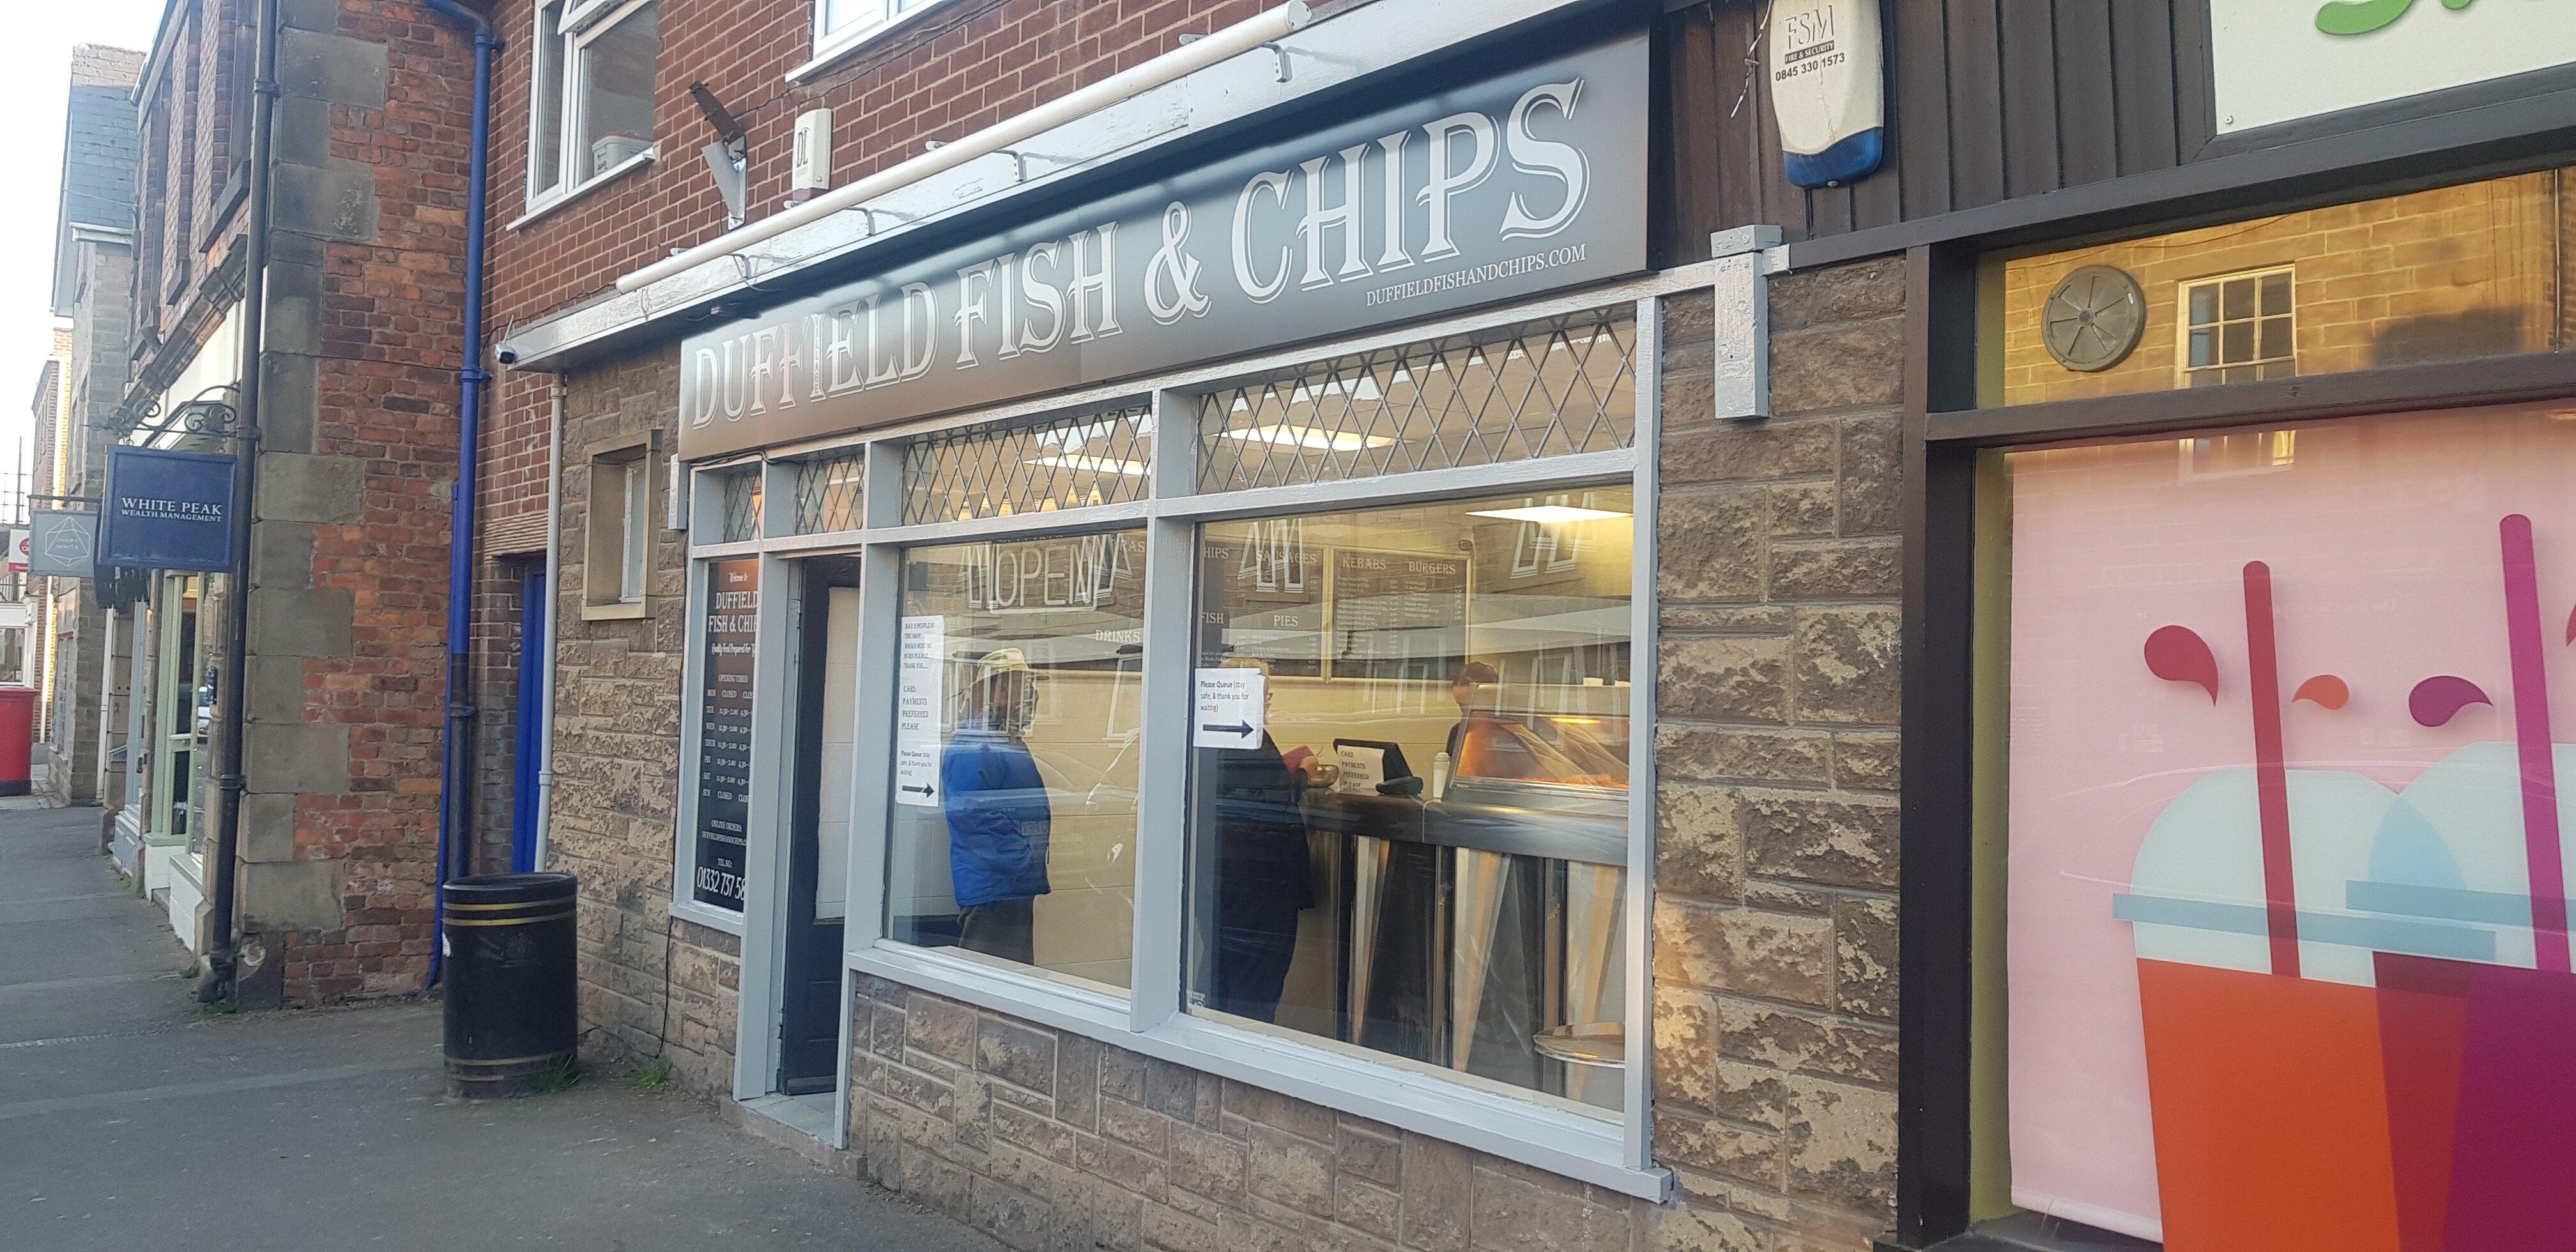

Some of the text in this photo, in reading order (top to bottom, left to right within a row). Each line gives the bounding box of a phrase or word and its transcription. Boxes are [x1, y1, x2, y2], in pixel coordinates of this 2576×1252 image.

[1785, 5, 1834, 49] FSM
[1785, 41, 1834, 63] FIRE & SECURITY
[1775, 52, 1845, 81] 0845 330 1573
[693, 77, 1590, 429] DUFFIELD FISH & CHIPS
[1366, 243, 1586, 307] DUFFIELDFISHANDCHIPS.COM
[121, 498, 222, 515] WHITE PEAK
[121, 509, 222, 523] WEALTH MANAGEMENT
[1204, 547, 1229, 559] HIPS
[1342, 557, 1386, 570] KEBABS
[1409, 561, 1455, 575] BURGERS
[995, 544, 1095, 606] OPEN
[716, 590, 758, 609] DUFFIELD
[708, 615, 757, 633] FISH & CHIP
[1273, 615, 1298, 627] PIES
[1095, 630, 1140, 643] DRINKS
[1234, 681, 1245, 689] (stay
[722, 690, 737, 698] CLOSED
[742, 691, 753, 699] CLOS
[1200, 704, 1218, 713] waiting)
[1342, 761, 1365, 769] PAYMENTS
[1343, 771, 1368, 779] PREFERRED
[717, 791, 733, 800] CLOSED
[738, 793, 749, 803] CLOS
[697, 866, 746, 901] 01332 737 58
